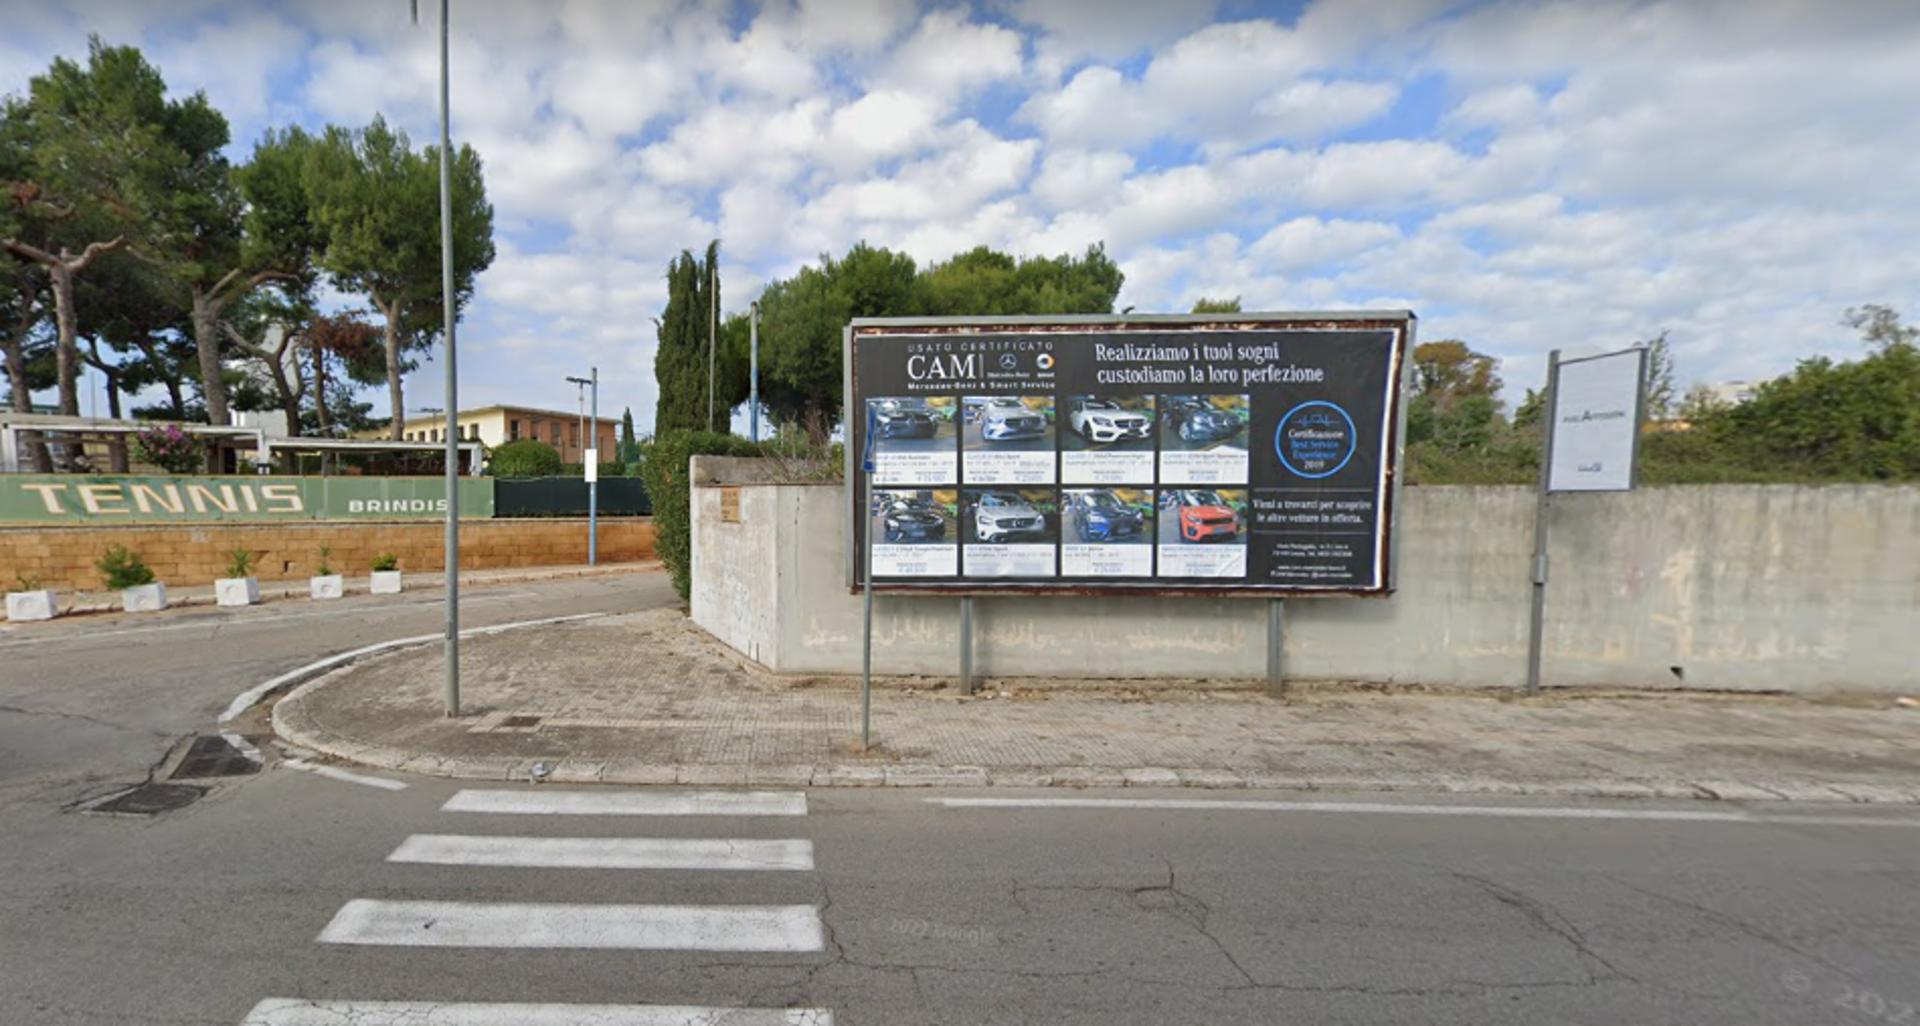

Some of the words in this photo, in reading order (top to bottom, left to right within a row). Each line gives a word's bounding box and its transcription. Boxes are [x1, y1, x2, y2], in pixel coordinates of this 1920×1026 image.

[907, 343, 952, 353] USATO
[960, 341, 1054, 351] CERTIFICATO
[1094, 343, 1190, 361] Realizziamo
[1193, 343, 1199, 361] i
[1203, 343, 1233, 361] tuoi
[1237, 343, 1280, 365] sogni
[907, 353, 977, 380] CAM
[1097, 366, 1186, 384] custodiamo
[1190, 366, 1204, 383] la
[1208, 366, 1238, 383] loro
[1242, 364, 1325, 387] perfezione
[907, 382, 977, 390] Mercedes-Benz
[980, 382, 986, 390] &
[989, 382, 1019, 390] Smart
[1021, 381, 1056, 389] Service
[20, 483, 304, 514] TENNIS
[348, 499, 449, 513] BRINDIS
